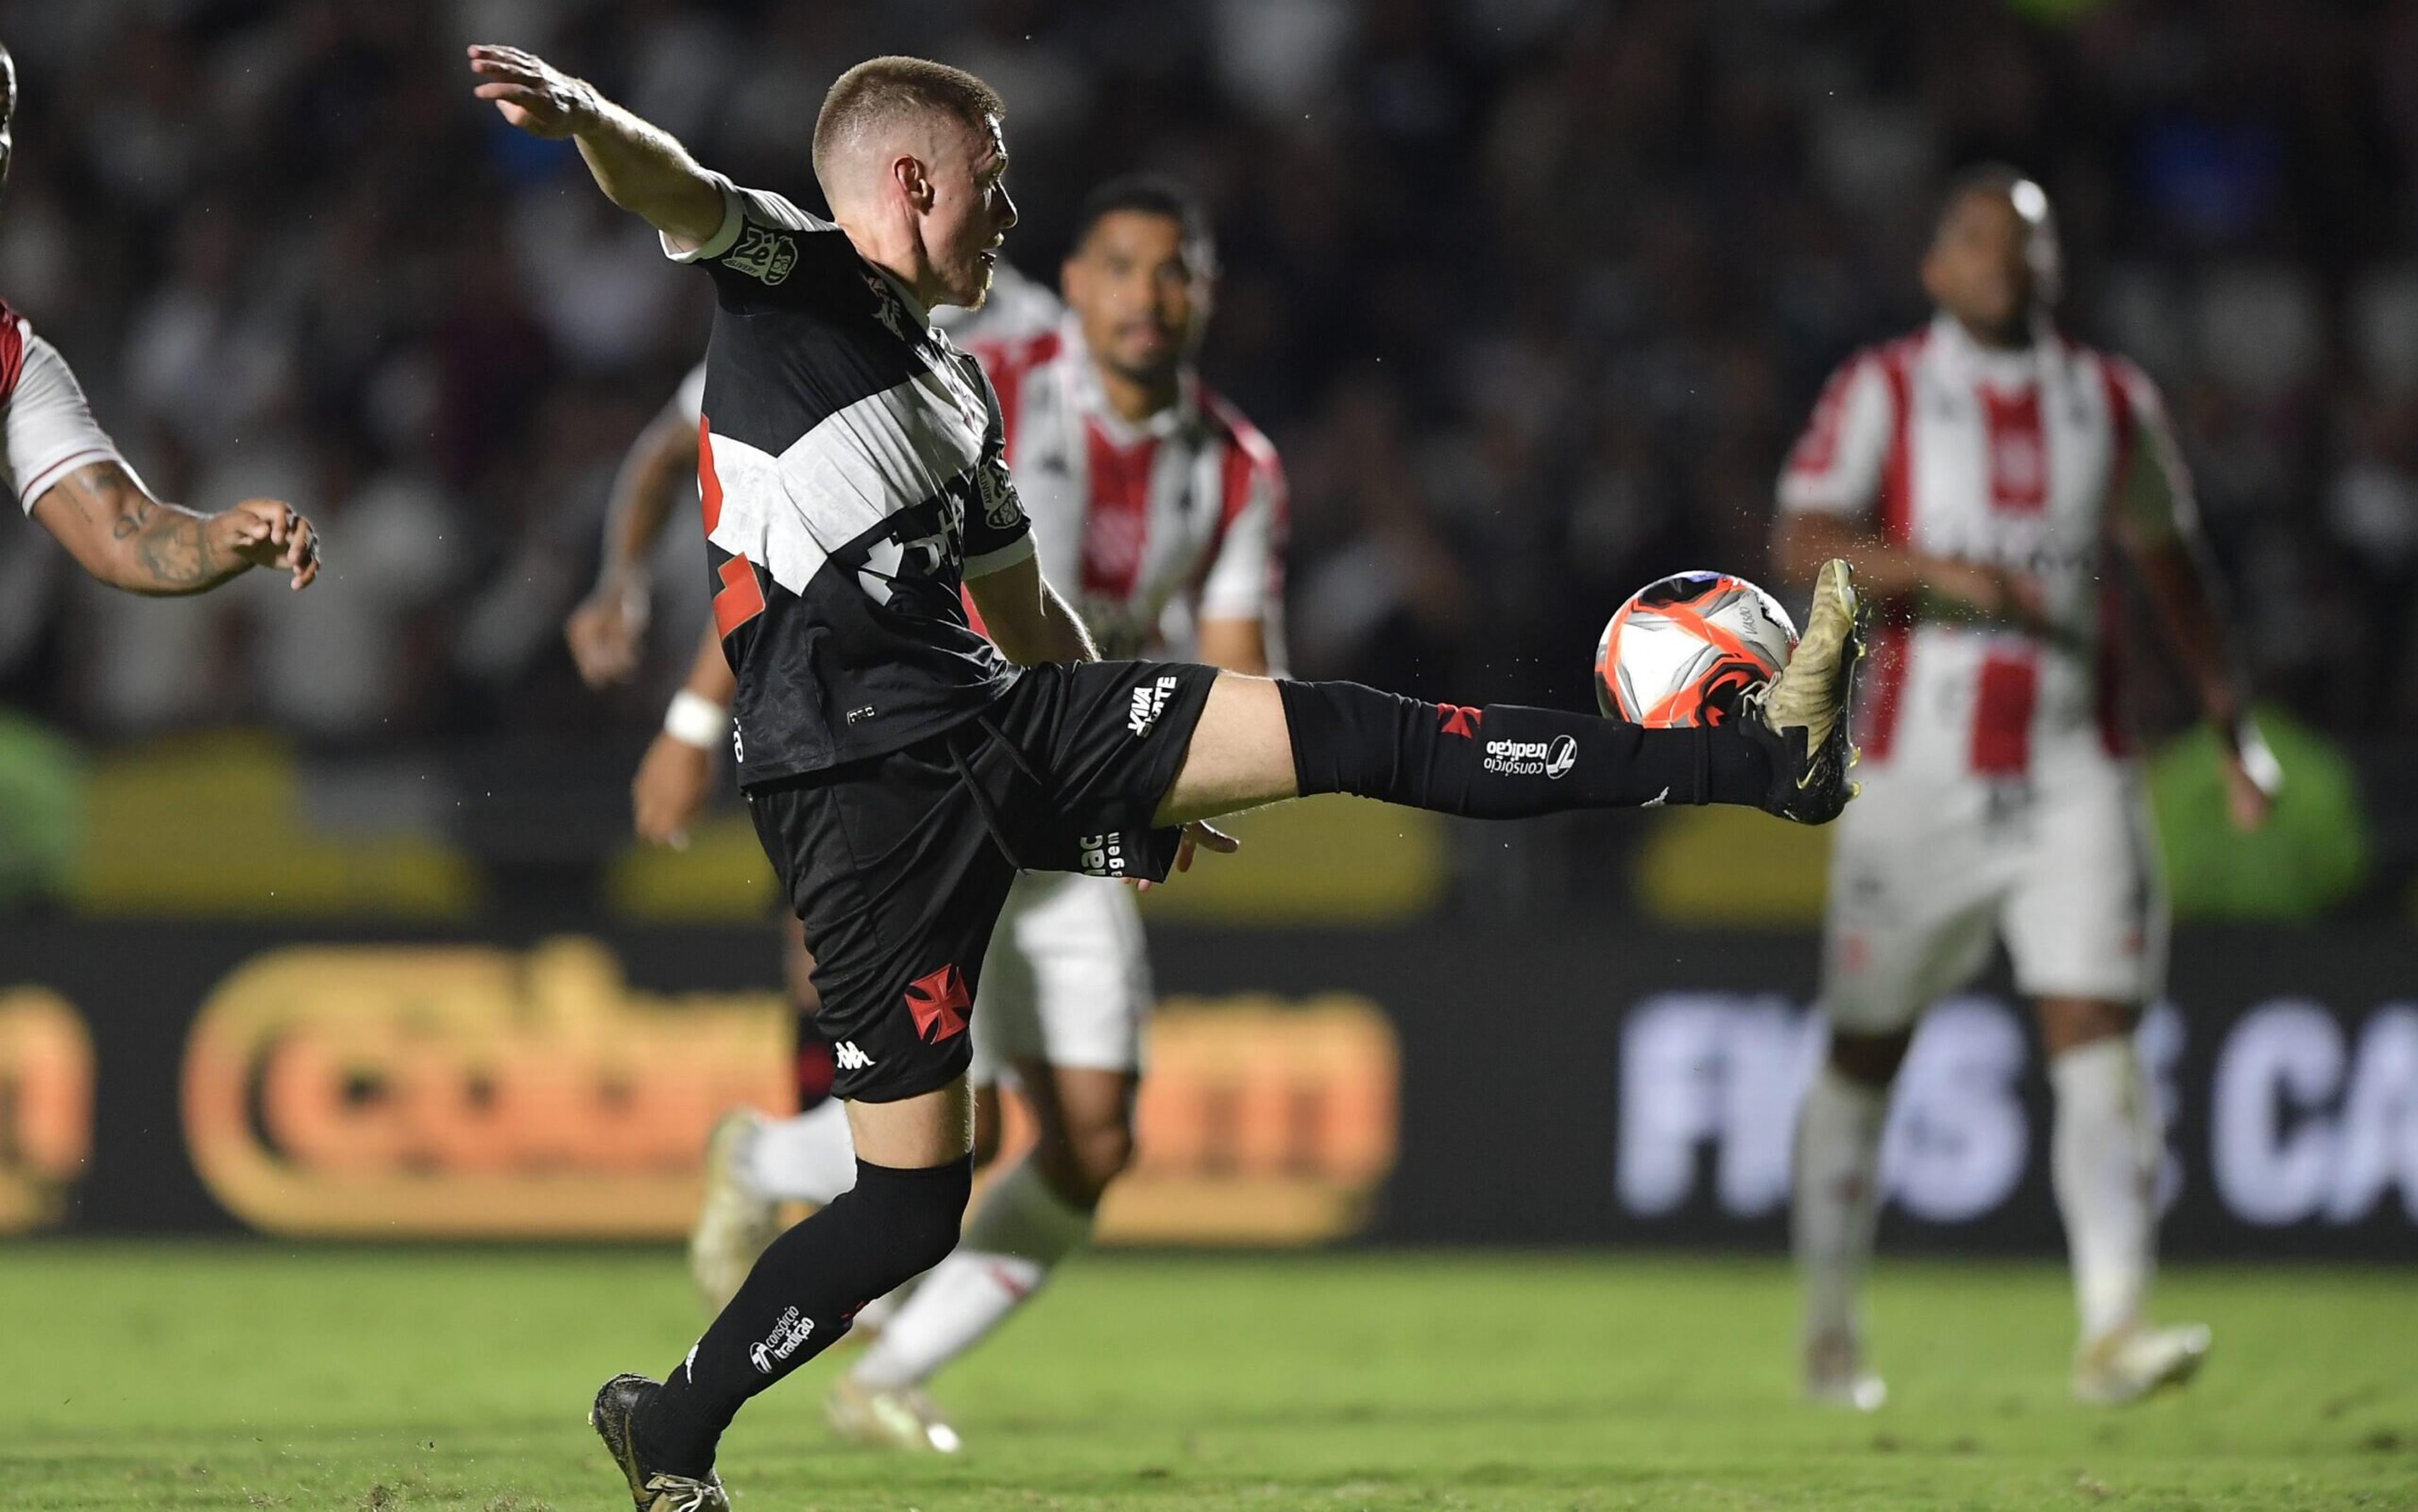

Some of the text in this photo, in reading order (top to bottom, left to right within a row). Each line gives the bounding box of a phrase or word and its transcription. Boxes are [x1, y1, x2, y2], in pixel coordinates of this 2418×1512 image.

[1127, 687, 1153, 731] VIVA
[1484, 758, 1544, 777] consórcio
[1486, 739, 1548, 761] tradição
[766, 1305, 800, 1348] consórcio
[774, 1317, 815, 1359] tradição
